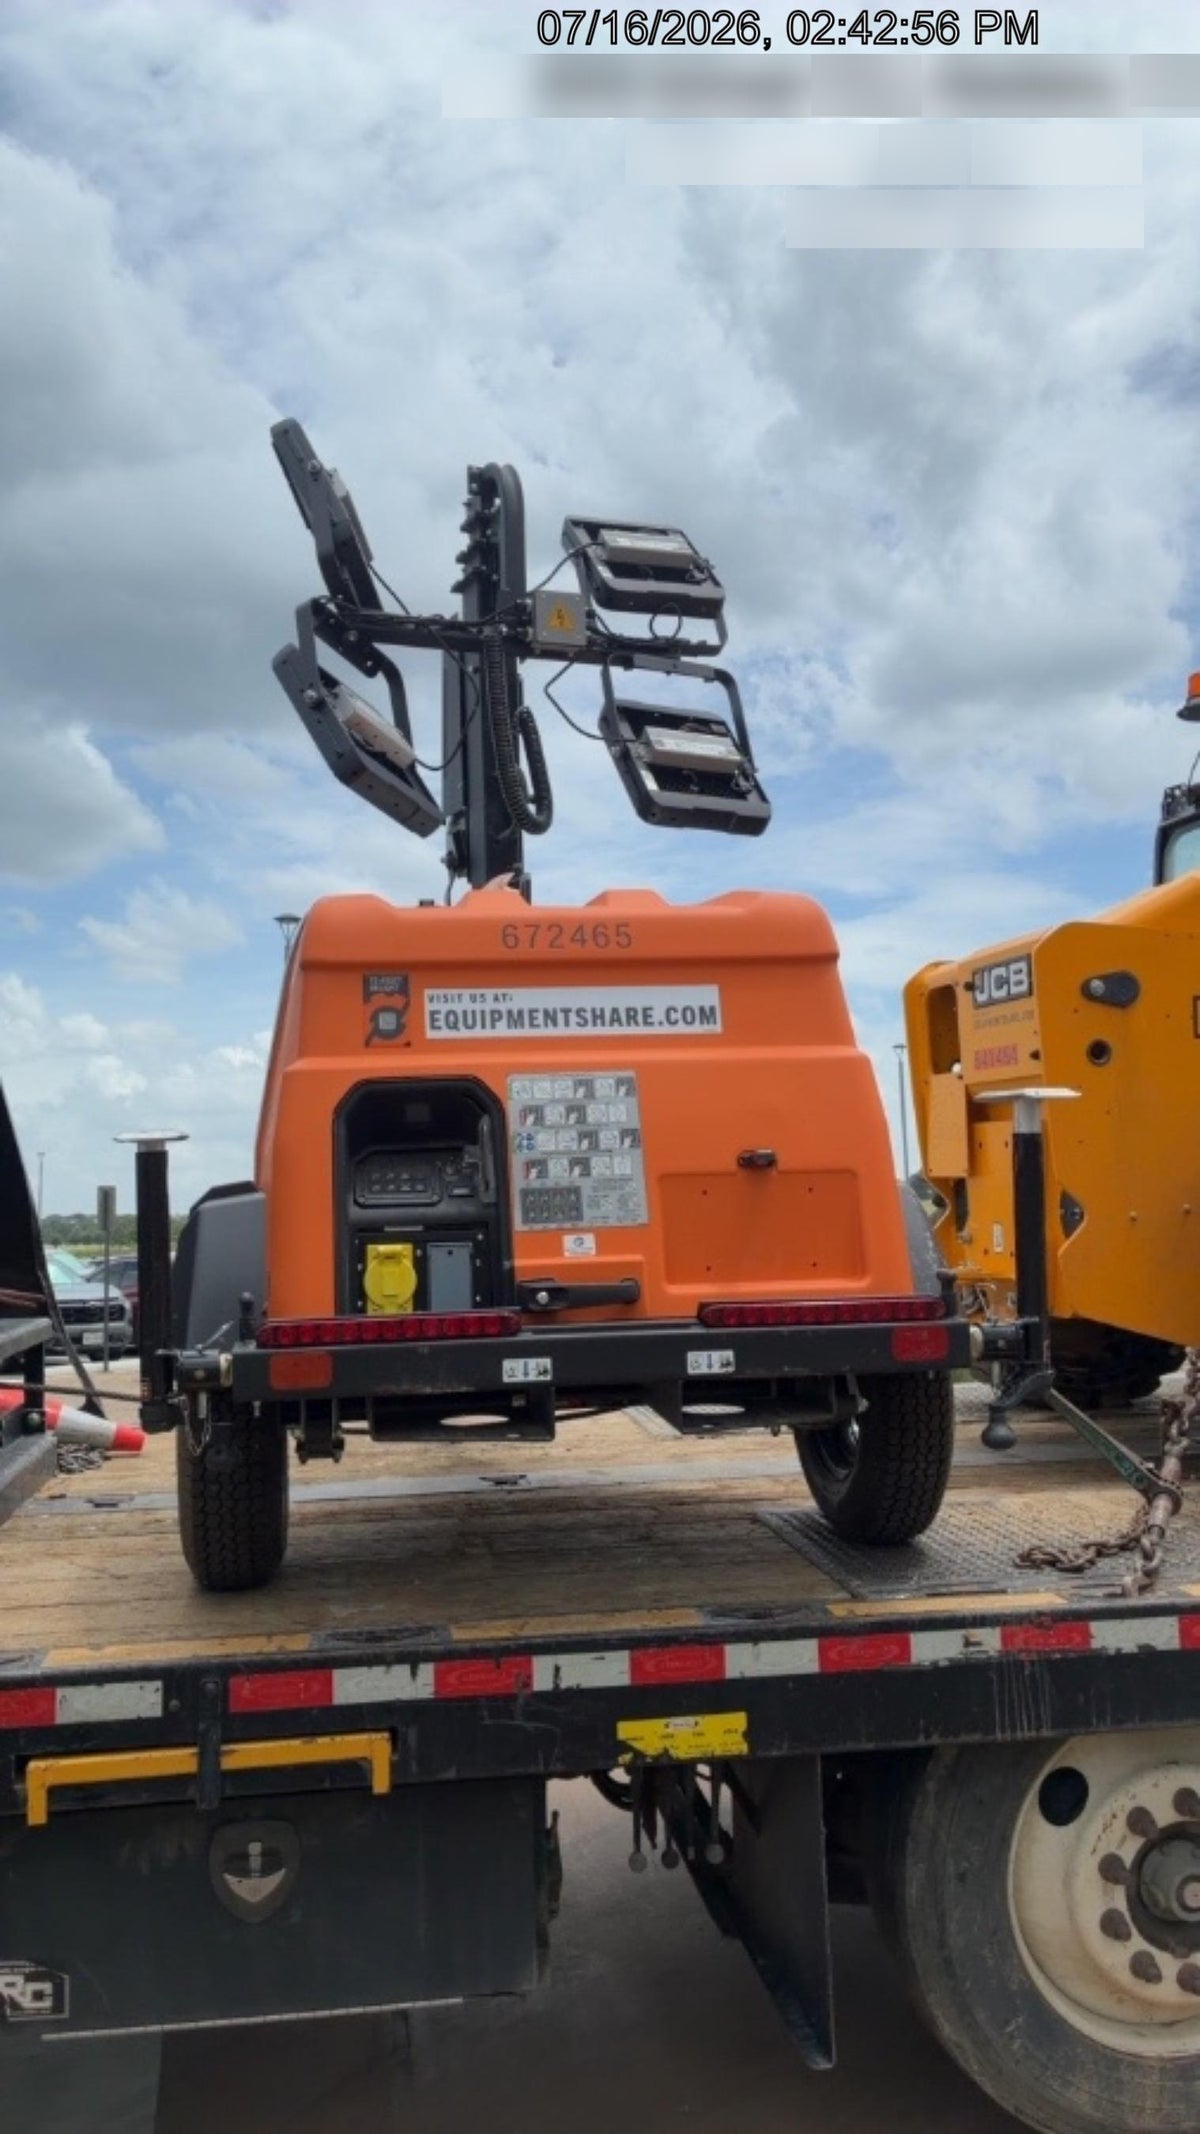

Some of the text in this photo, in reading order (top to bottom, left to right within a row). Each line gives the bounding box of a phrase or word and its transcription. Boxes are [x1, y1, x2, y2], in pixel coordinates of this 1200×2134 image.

[501, 922, 632, 949] 672465
[974, 960, 1030, 1005] JCB
[427, 993, 463, 1004] VISIT
[469, 993, 487, 1003] US
[428, 1005, 718, 1032] EQUIPMENTSHARE.COM
